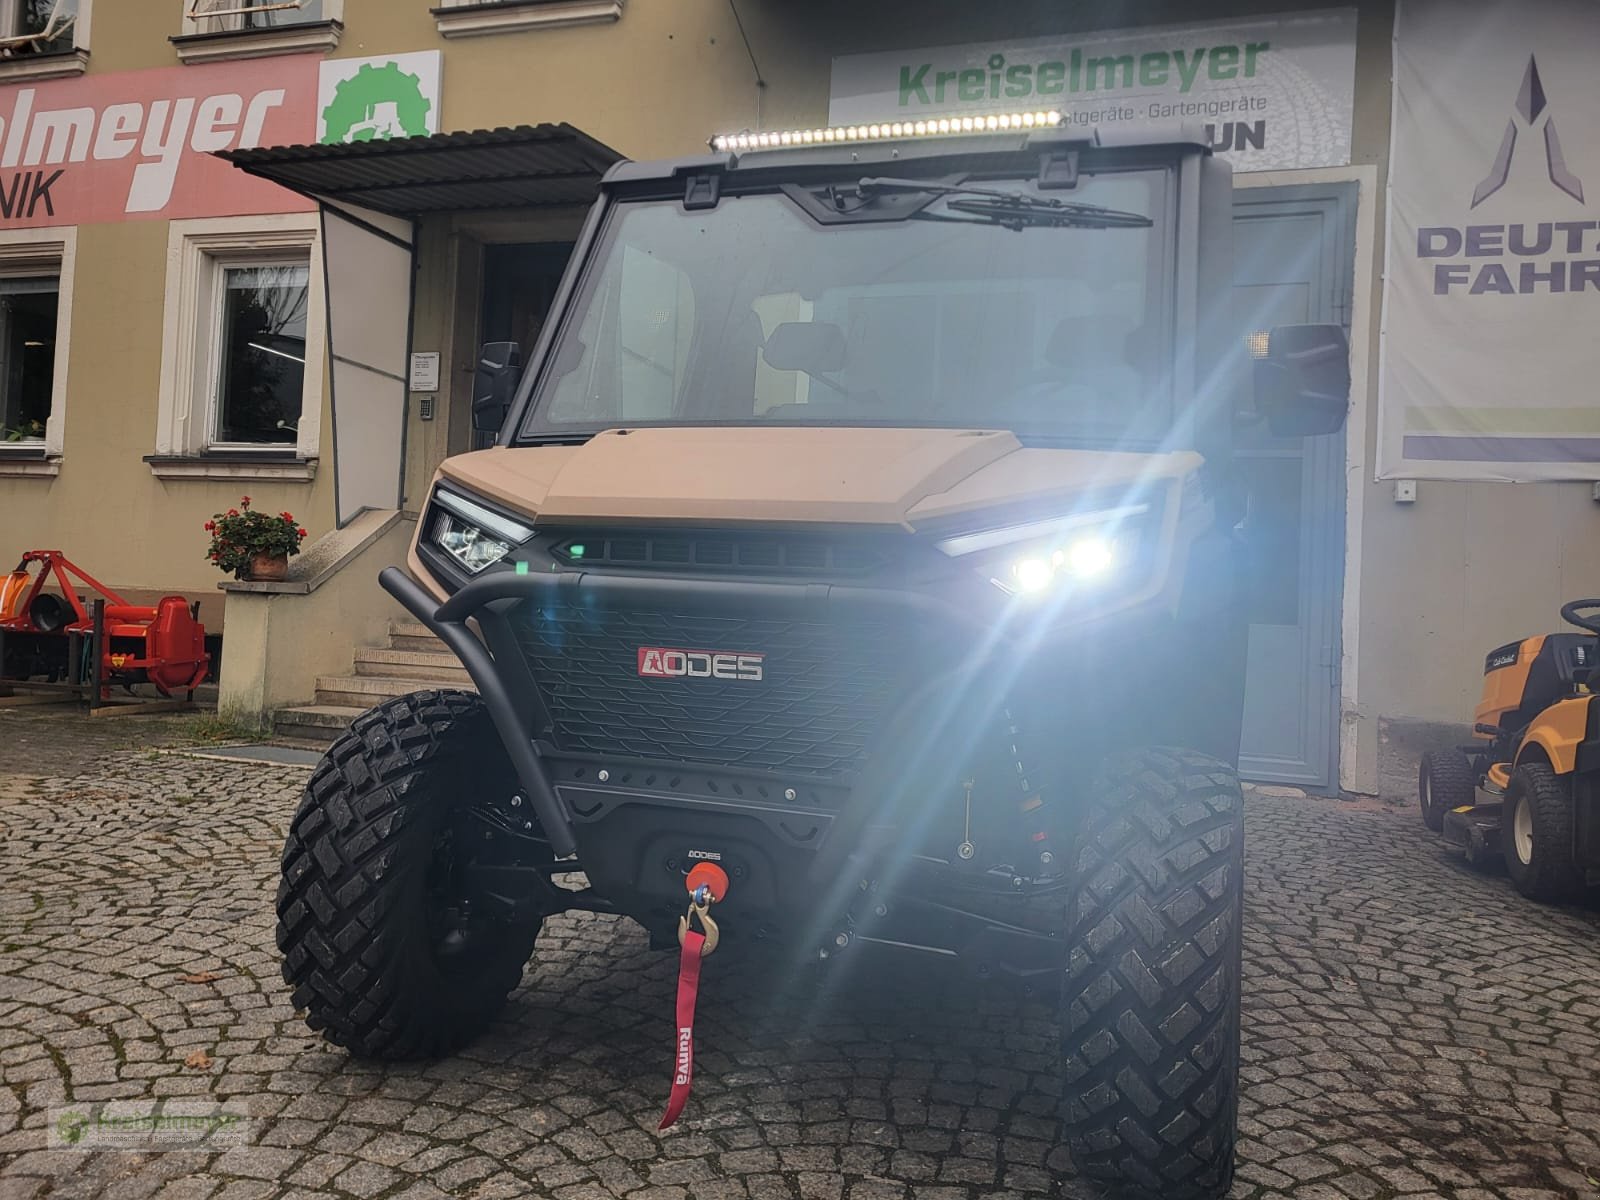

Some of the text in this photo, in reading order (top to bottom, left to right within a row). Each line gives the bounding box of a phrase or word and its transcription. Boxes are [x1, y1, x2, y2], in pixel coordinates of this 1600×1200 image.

[899, 41, 1269, 106] Kreiselmeyer
[1148, 96, 1267, 119] Gartengeräte
[0, 88, 285, 212] lmeyer
[1417, 222, 1600, 258] DEUT
[1434, 260, 1600, 295] FAHR
[641, 650, 762, 680] AODES
[687, 850, 721, 861] AODES
[676, 1027, 692, 1085] Runva
